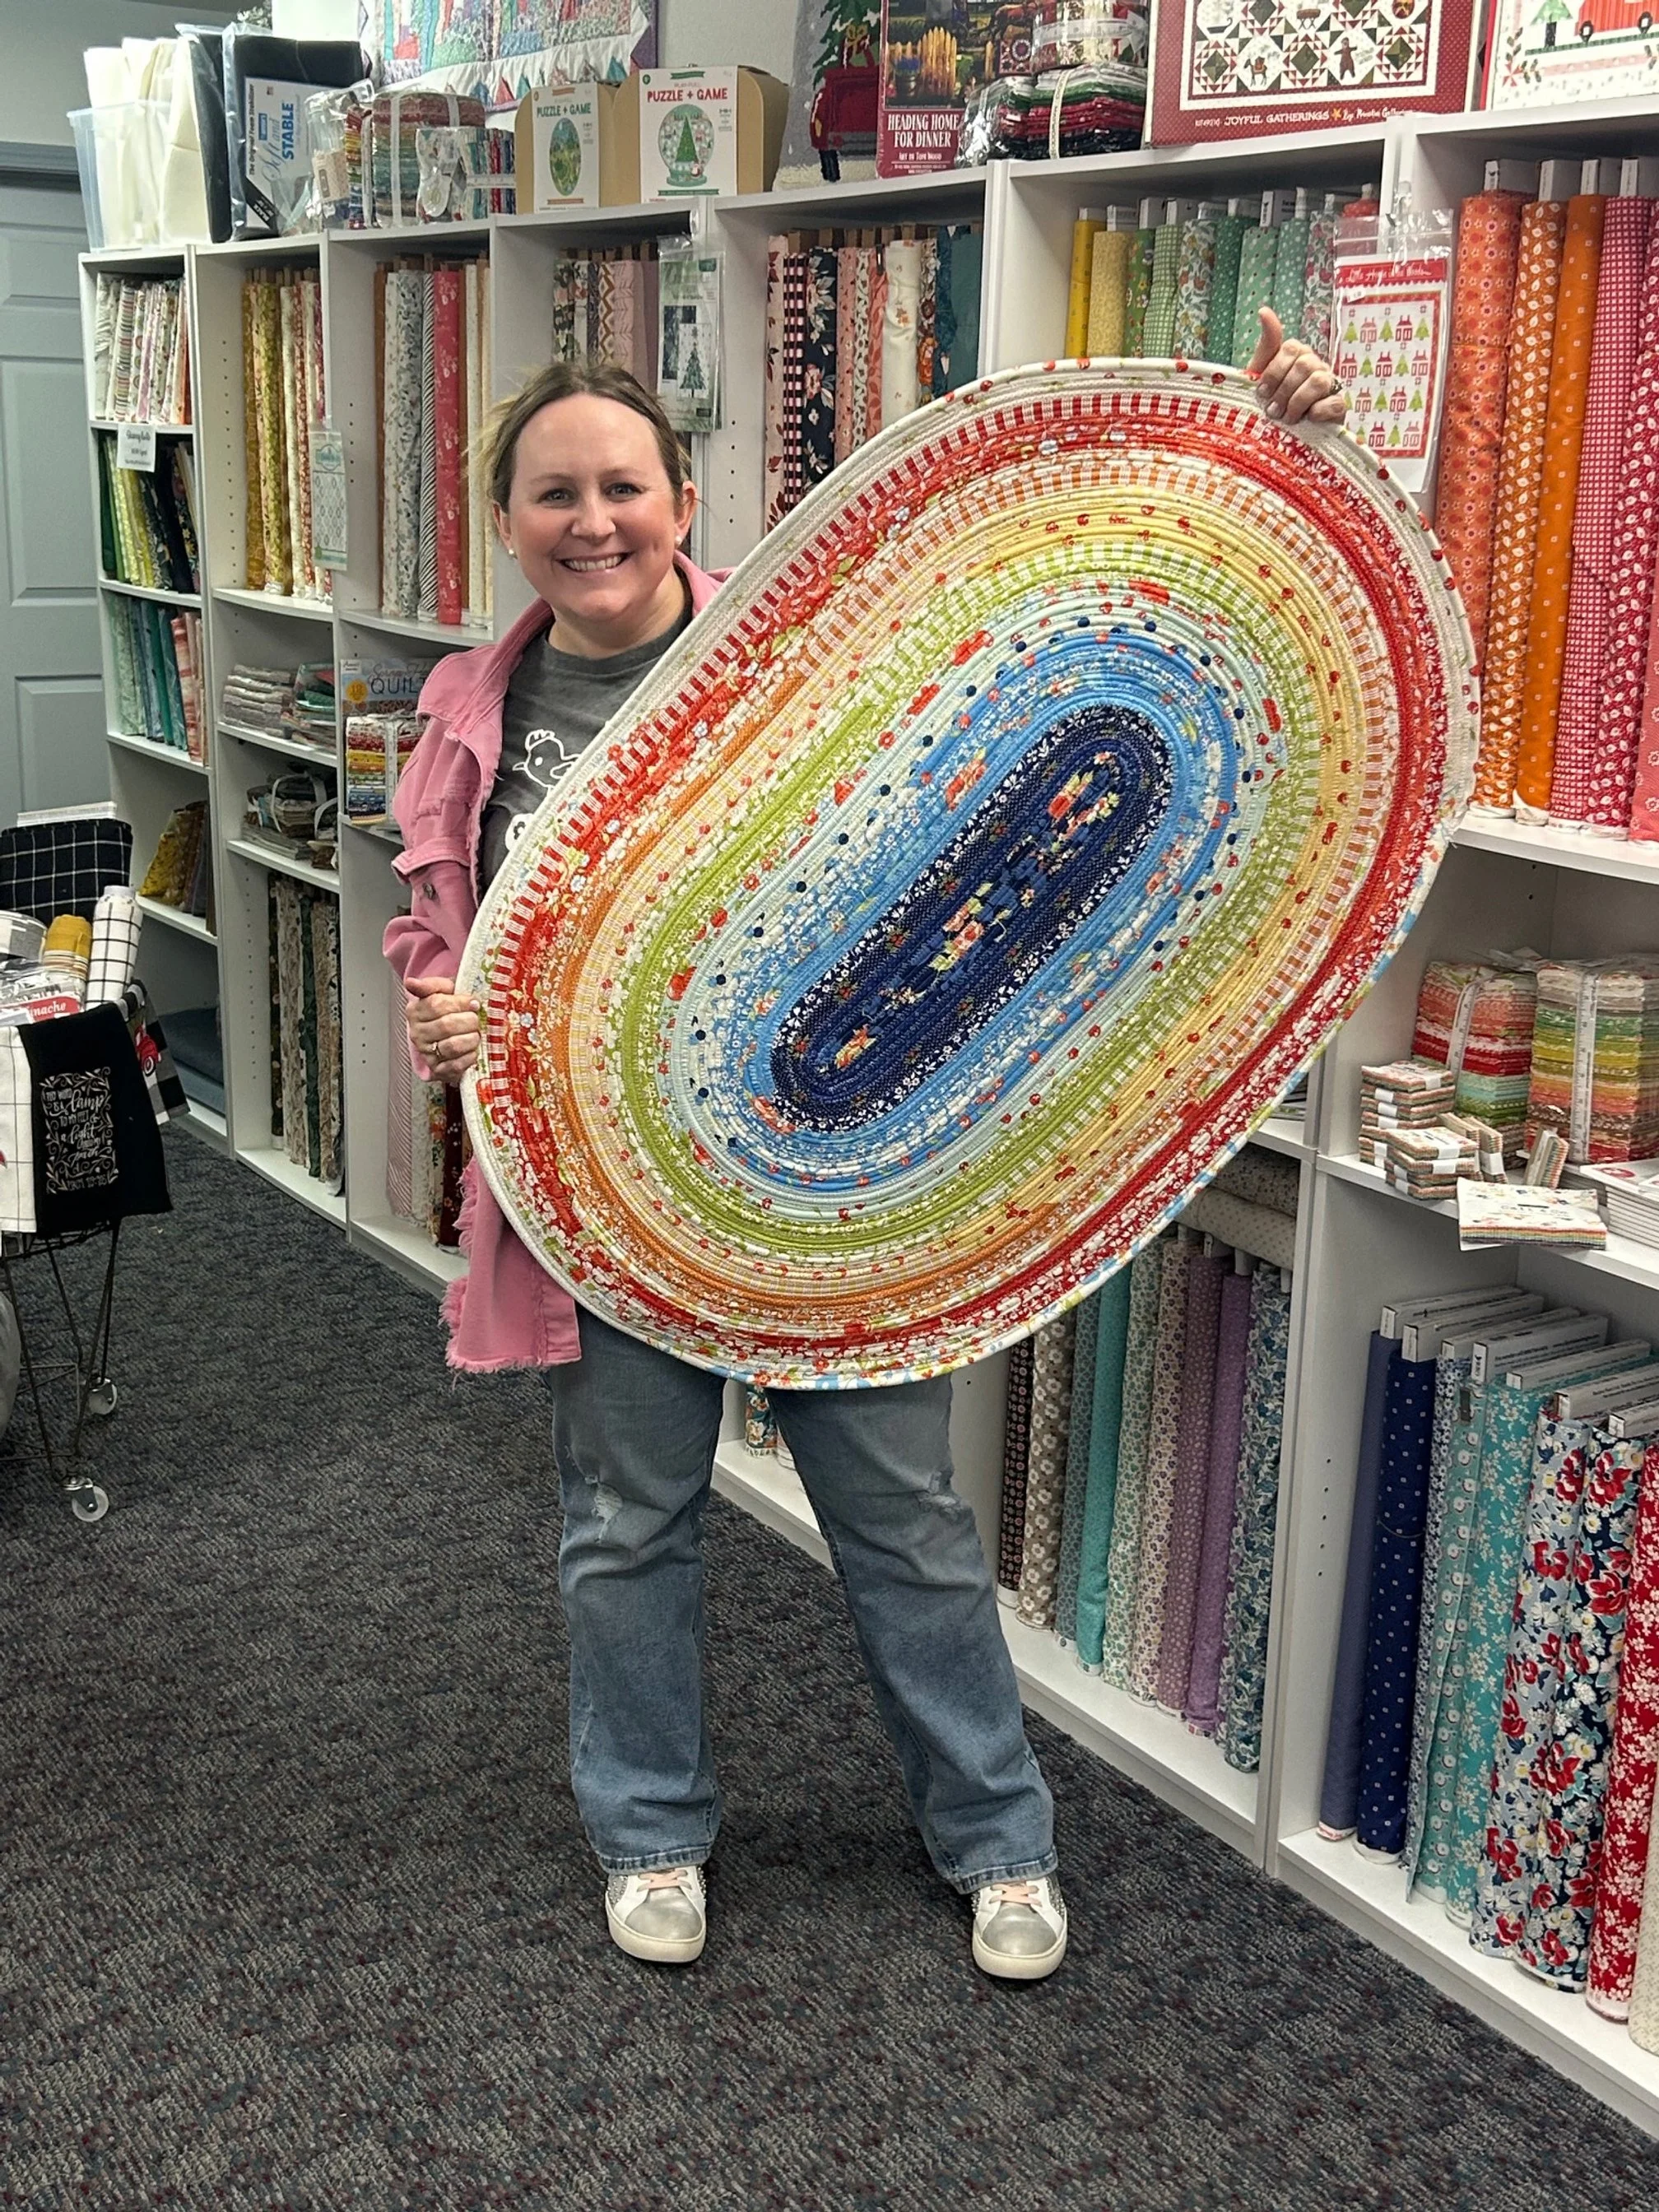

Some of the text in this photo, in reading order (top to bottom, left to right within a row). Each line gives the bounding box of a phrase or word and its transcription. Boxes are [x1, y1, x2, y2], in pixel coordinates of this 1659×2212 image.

[647, 90, 684, 103] PUZZLE
[696, 88, 728, 101] GAME
[537, 104, 560, 118] PUZZLE
[569, 102, 592, 115] GAME
[1224, 114, 1263, 126] JOYFUL
[1266, 109, 1330, 123] GATHERINGS
[888, 114, 960, 131] HEADING HOME
[281, 103, 294, 160] STABLE
[894, 131, 913, 148] FOR
[915, 131, 951, 148] DINNER
[69, 1089, 105, 1113] lamp
[69, 1122, 96, 1150] light
